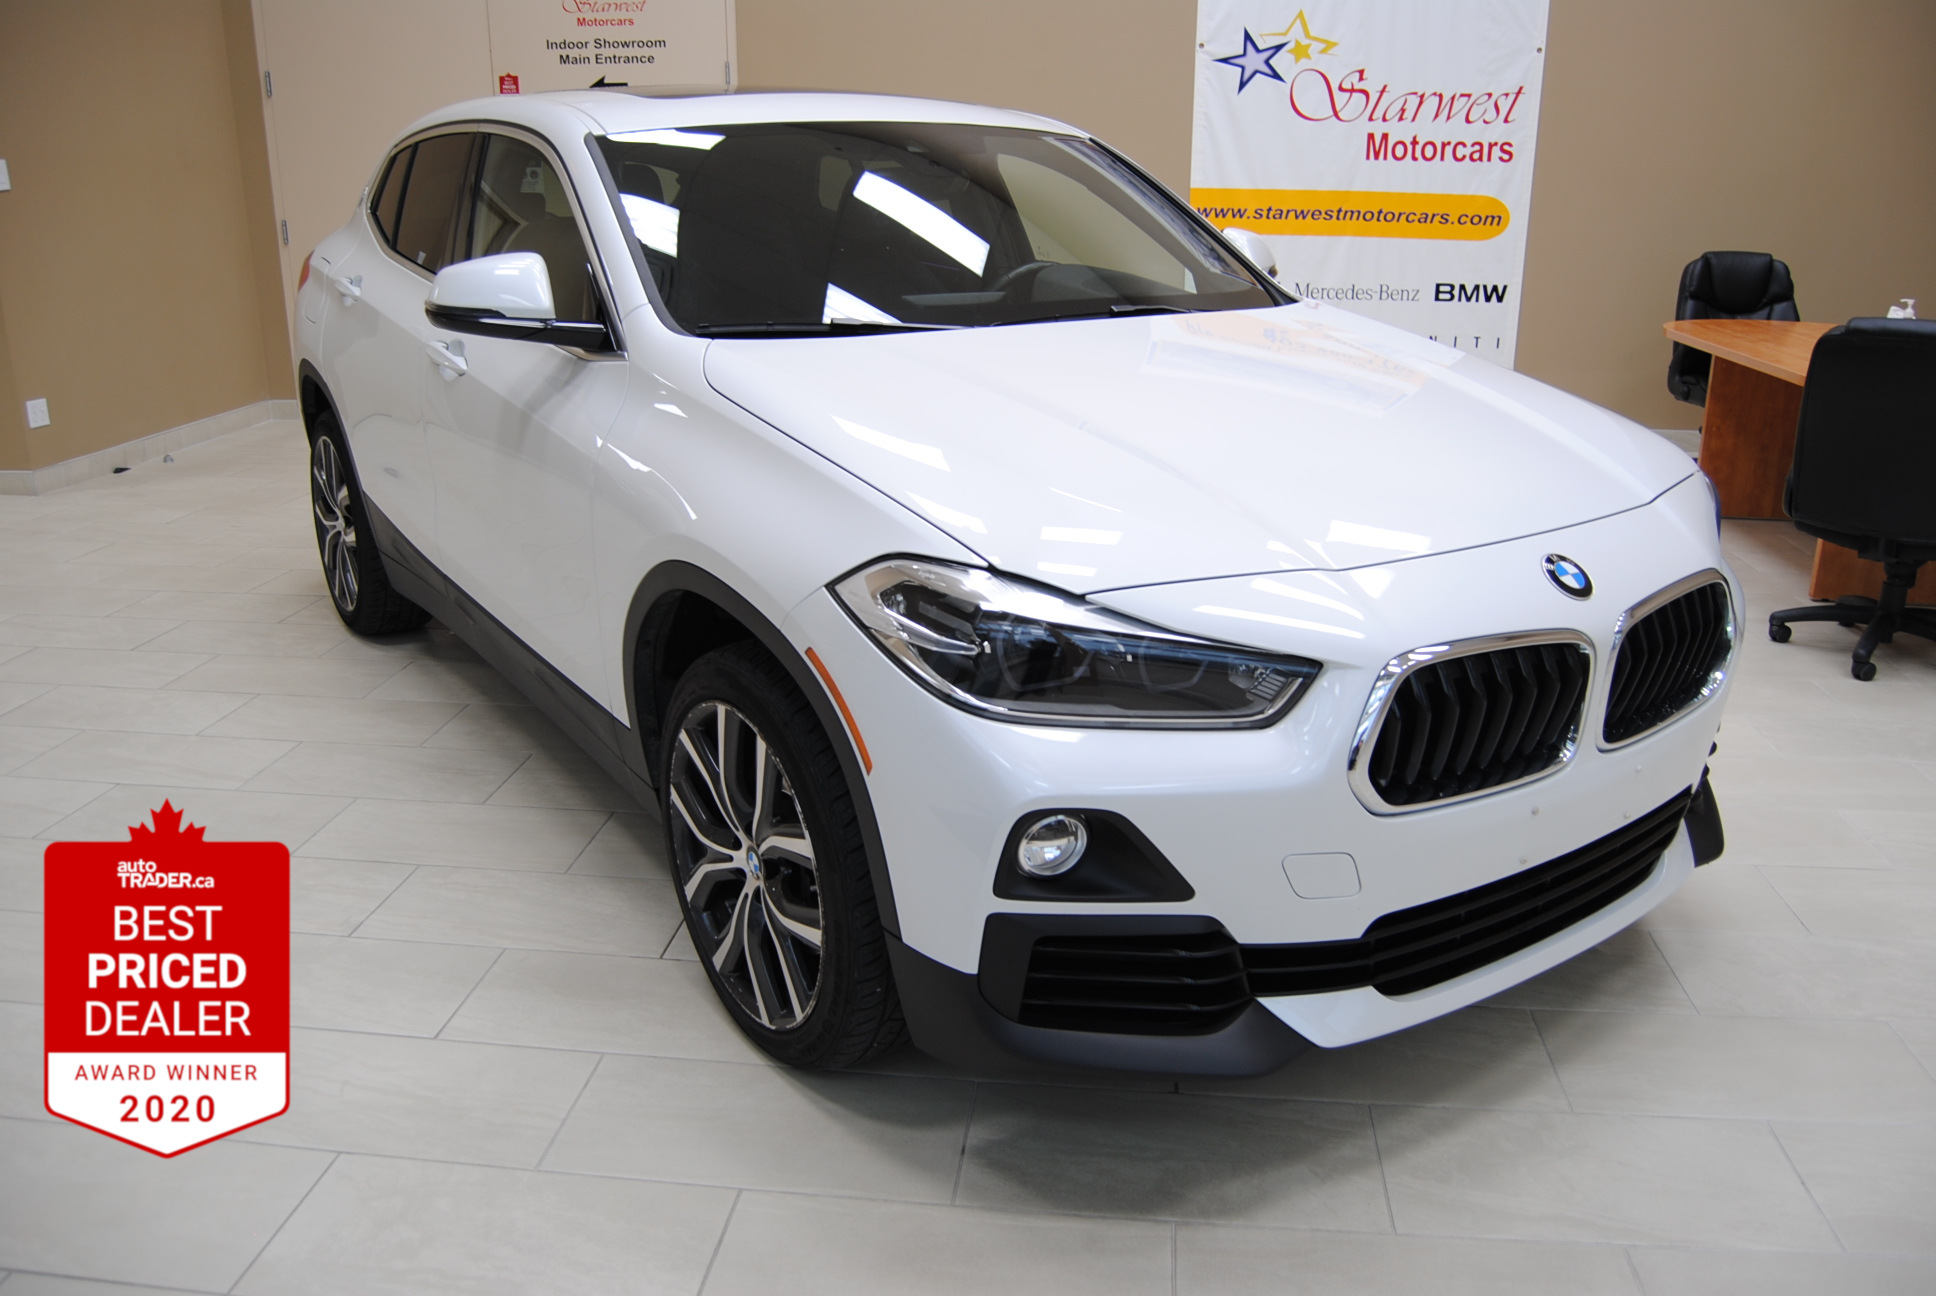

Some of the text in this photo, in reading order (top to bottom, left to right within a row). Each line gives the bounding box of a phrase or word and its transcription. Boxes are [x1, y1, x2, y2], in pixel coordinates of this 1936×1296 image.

[562, 0, 647, 14] Starwest
[577, 17, 635, 27] Motorcars
[546, 38, 667, 50] Indoor Showroom
[559, 53, 655, 65] Main Entrance
[1290, 68, 1526, 124] Starwest
[1365, 132, 1514, 163] Motorcars
[1196, 205, 1503, 227] www.starwestmotorcars.com
[1294, 282, 1420, 302] Mercedes-Benz
[1434, 283, 1508, 303] BMW
